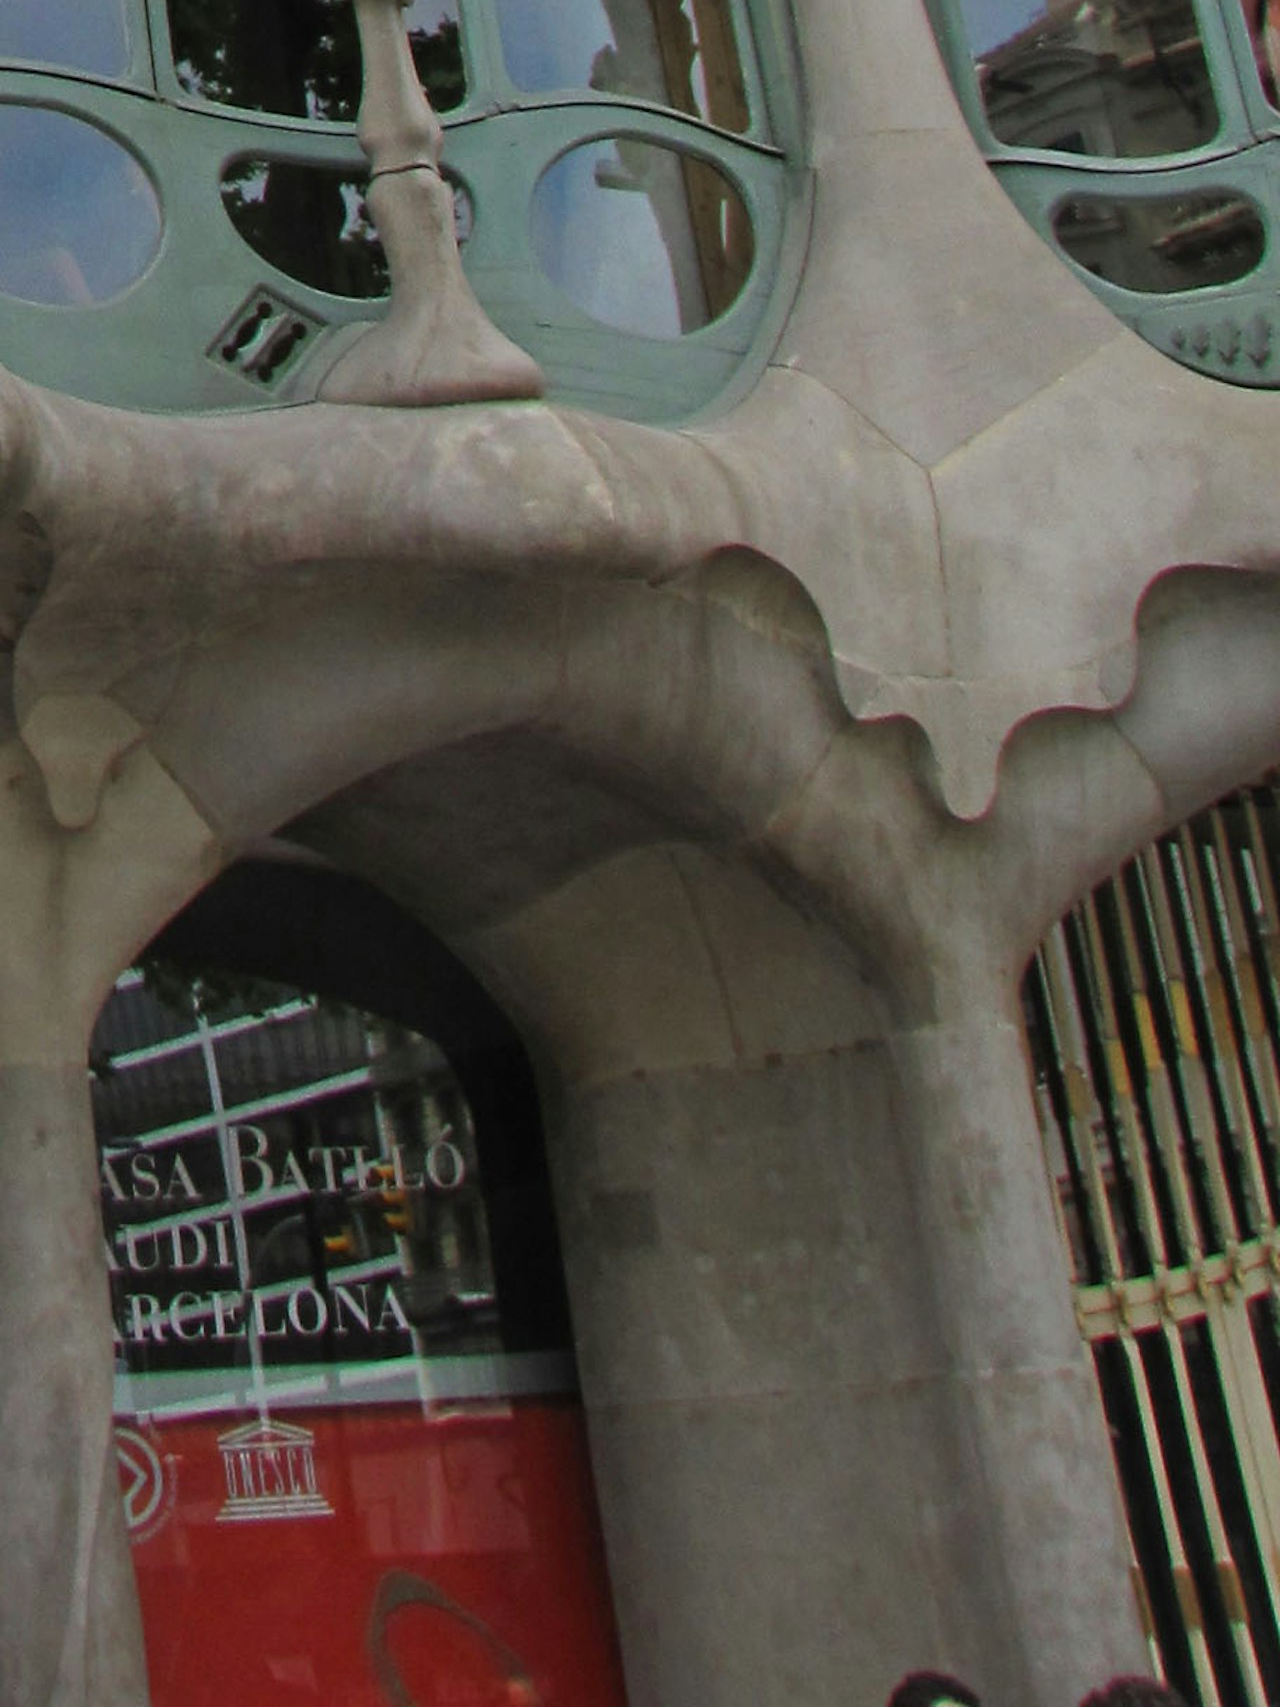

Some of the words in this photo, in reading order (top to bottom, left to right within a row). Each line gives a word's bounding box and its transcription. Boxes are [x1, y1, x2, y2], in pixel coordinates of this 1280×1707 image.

[100, 1153, 204, 1203] ASA
[226, 1123, 465, 1198] BATLLÓ
[113, 1283, 411, 1343] RCELONA
[223, 1443, 319, 1501] UNESCO
